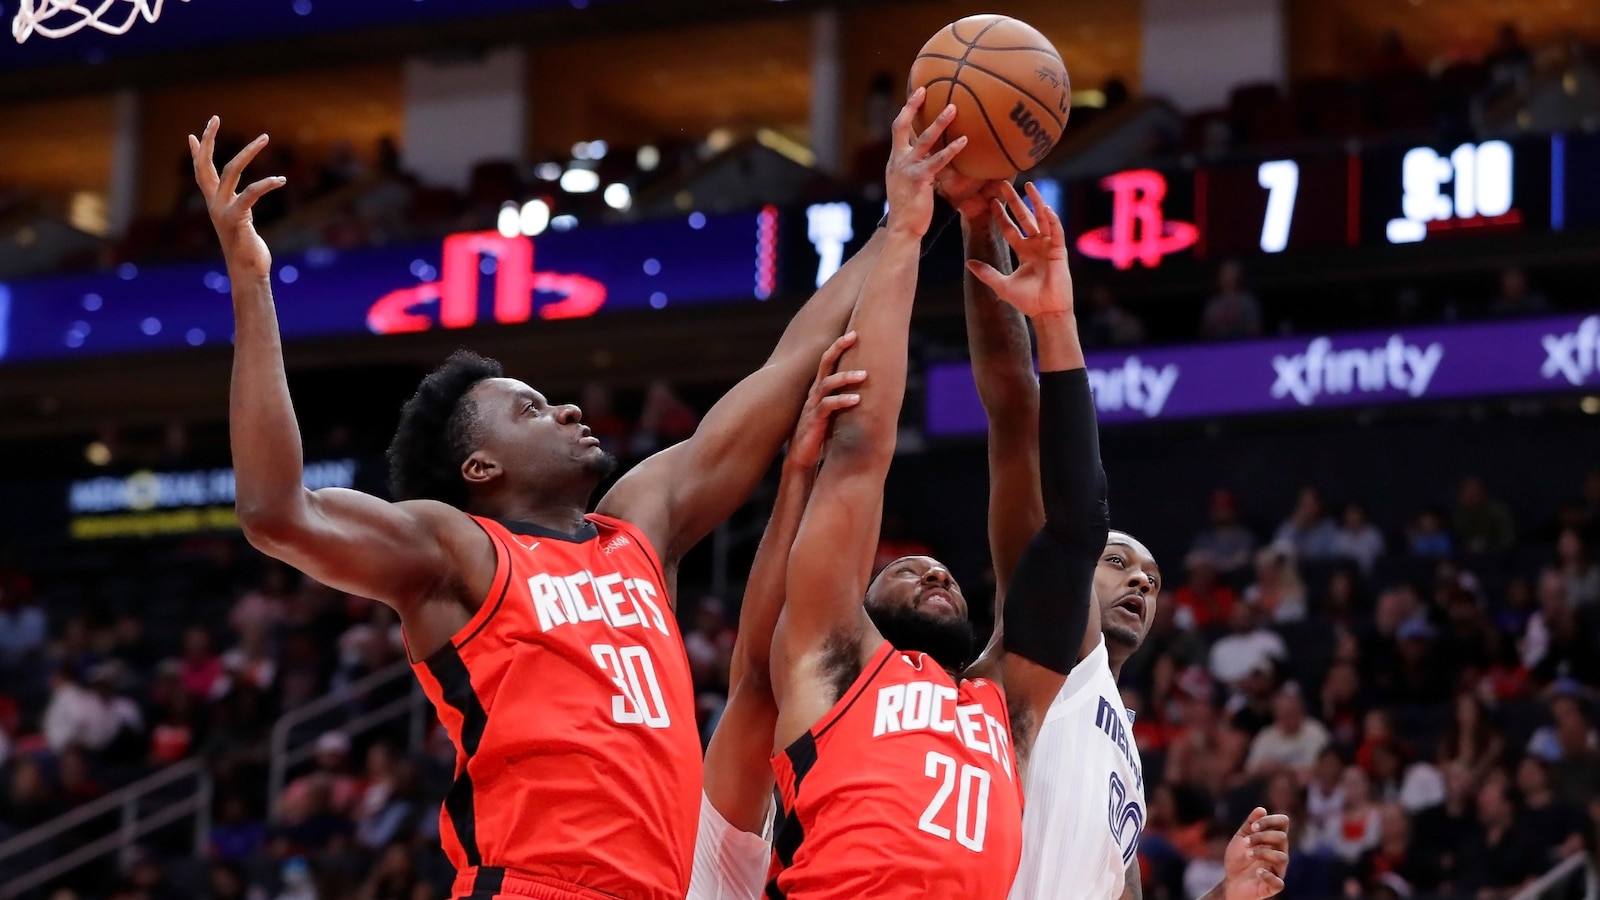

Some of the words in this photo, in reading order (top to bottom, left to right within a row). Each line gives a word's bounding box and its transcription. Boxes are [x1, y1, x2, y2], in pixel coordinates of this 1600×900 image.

[1258, 160, 1299, 252] 7
[1088, 356, 1179, 417] nity
[1271, 335, 1444, 405] xfinity
[590, 644, 671, 729] 30
[873, 681, 1013, 783] ROCETS
[917, 750, 991, 853] 20
